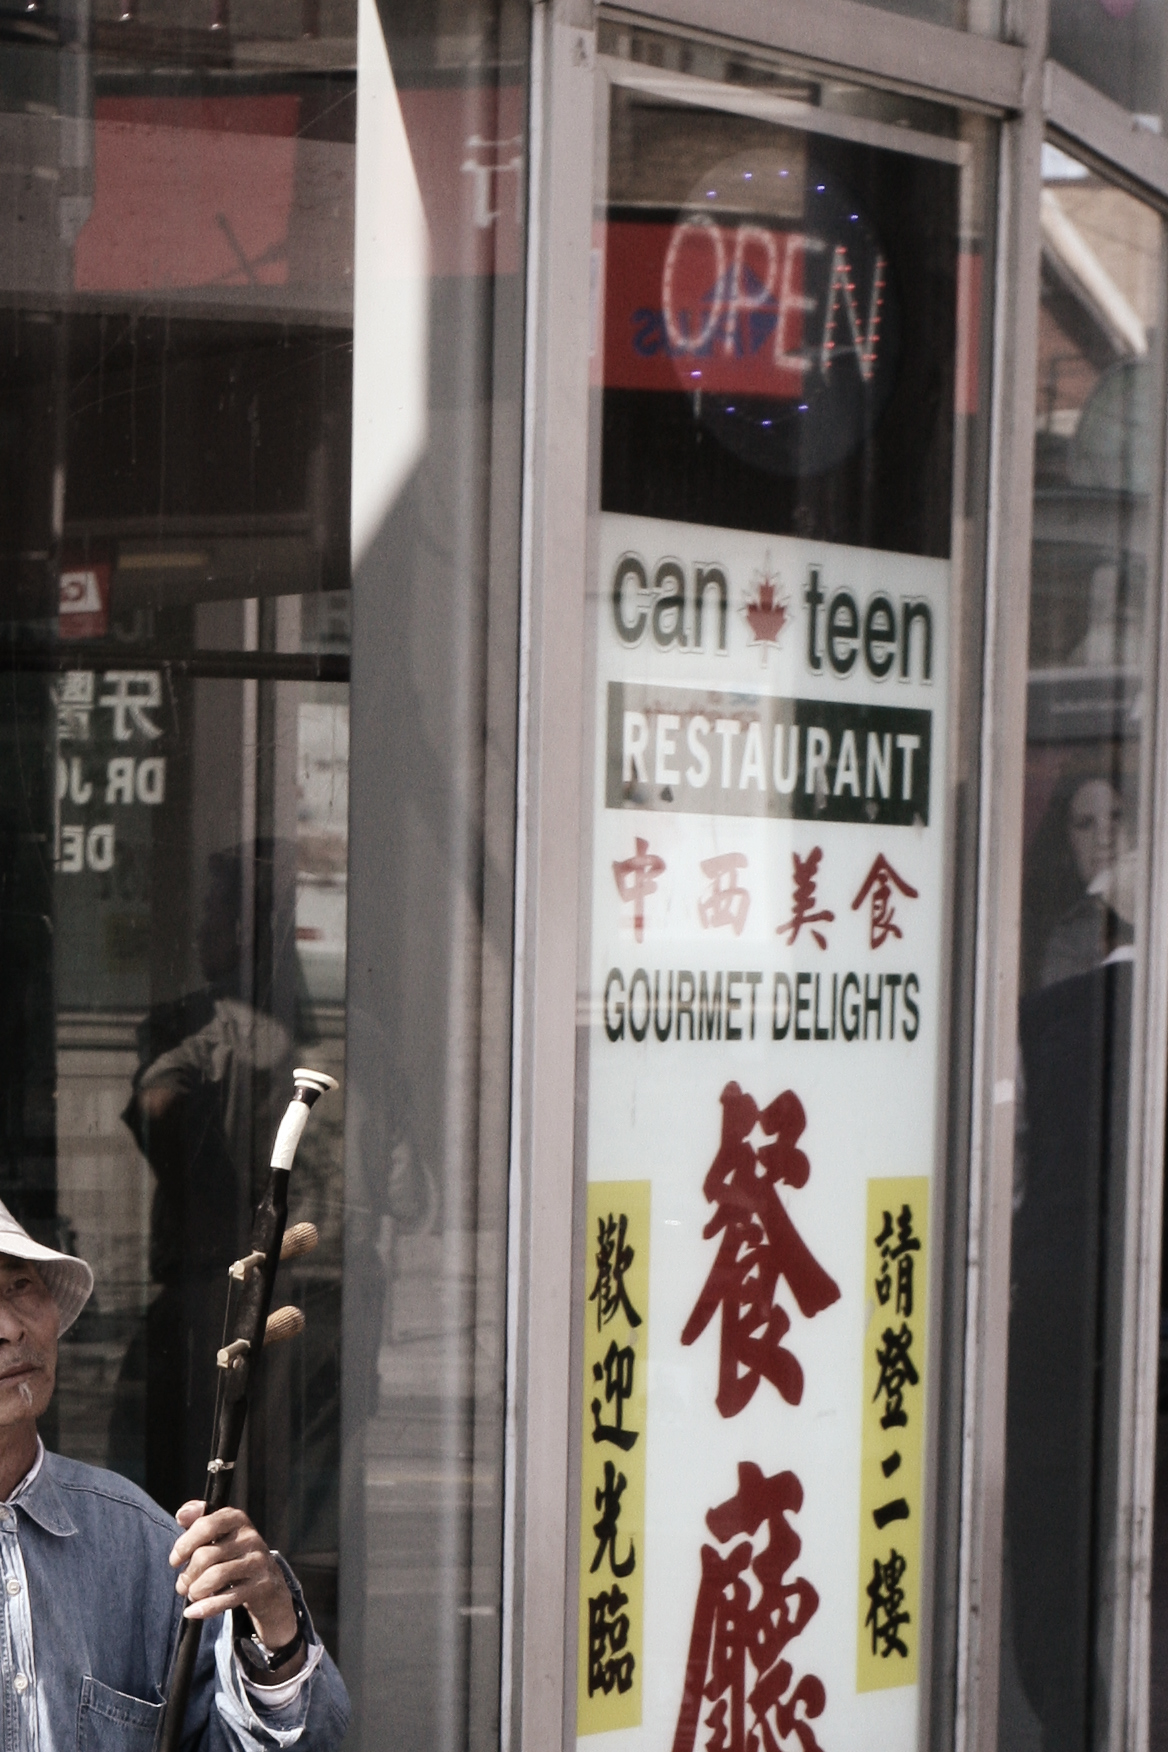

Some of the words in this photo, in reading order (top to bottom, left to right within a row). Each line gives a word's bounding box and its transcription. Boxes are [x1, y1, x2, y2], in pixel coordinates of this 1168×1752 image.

[661, 214, 887, 384] OPEN
[612, 551, 728, 655] can
[804, 563, 933, 686] teen
[622, 711, 921, 801] RESTAURANT
[612, 837, 919, 952] 中西美食
[604, 968, 762, 1043] GOURMET
[772, 972, 920, 1043] DELIGHTS
[588, 1212, 642, 1699] 歡迎光臨
[865, 1204, 921, 1659] 請登二樓
